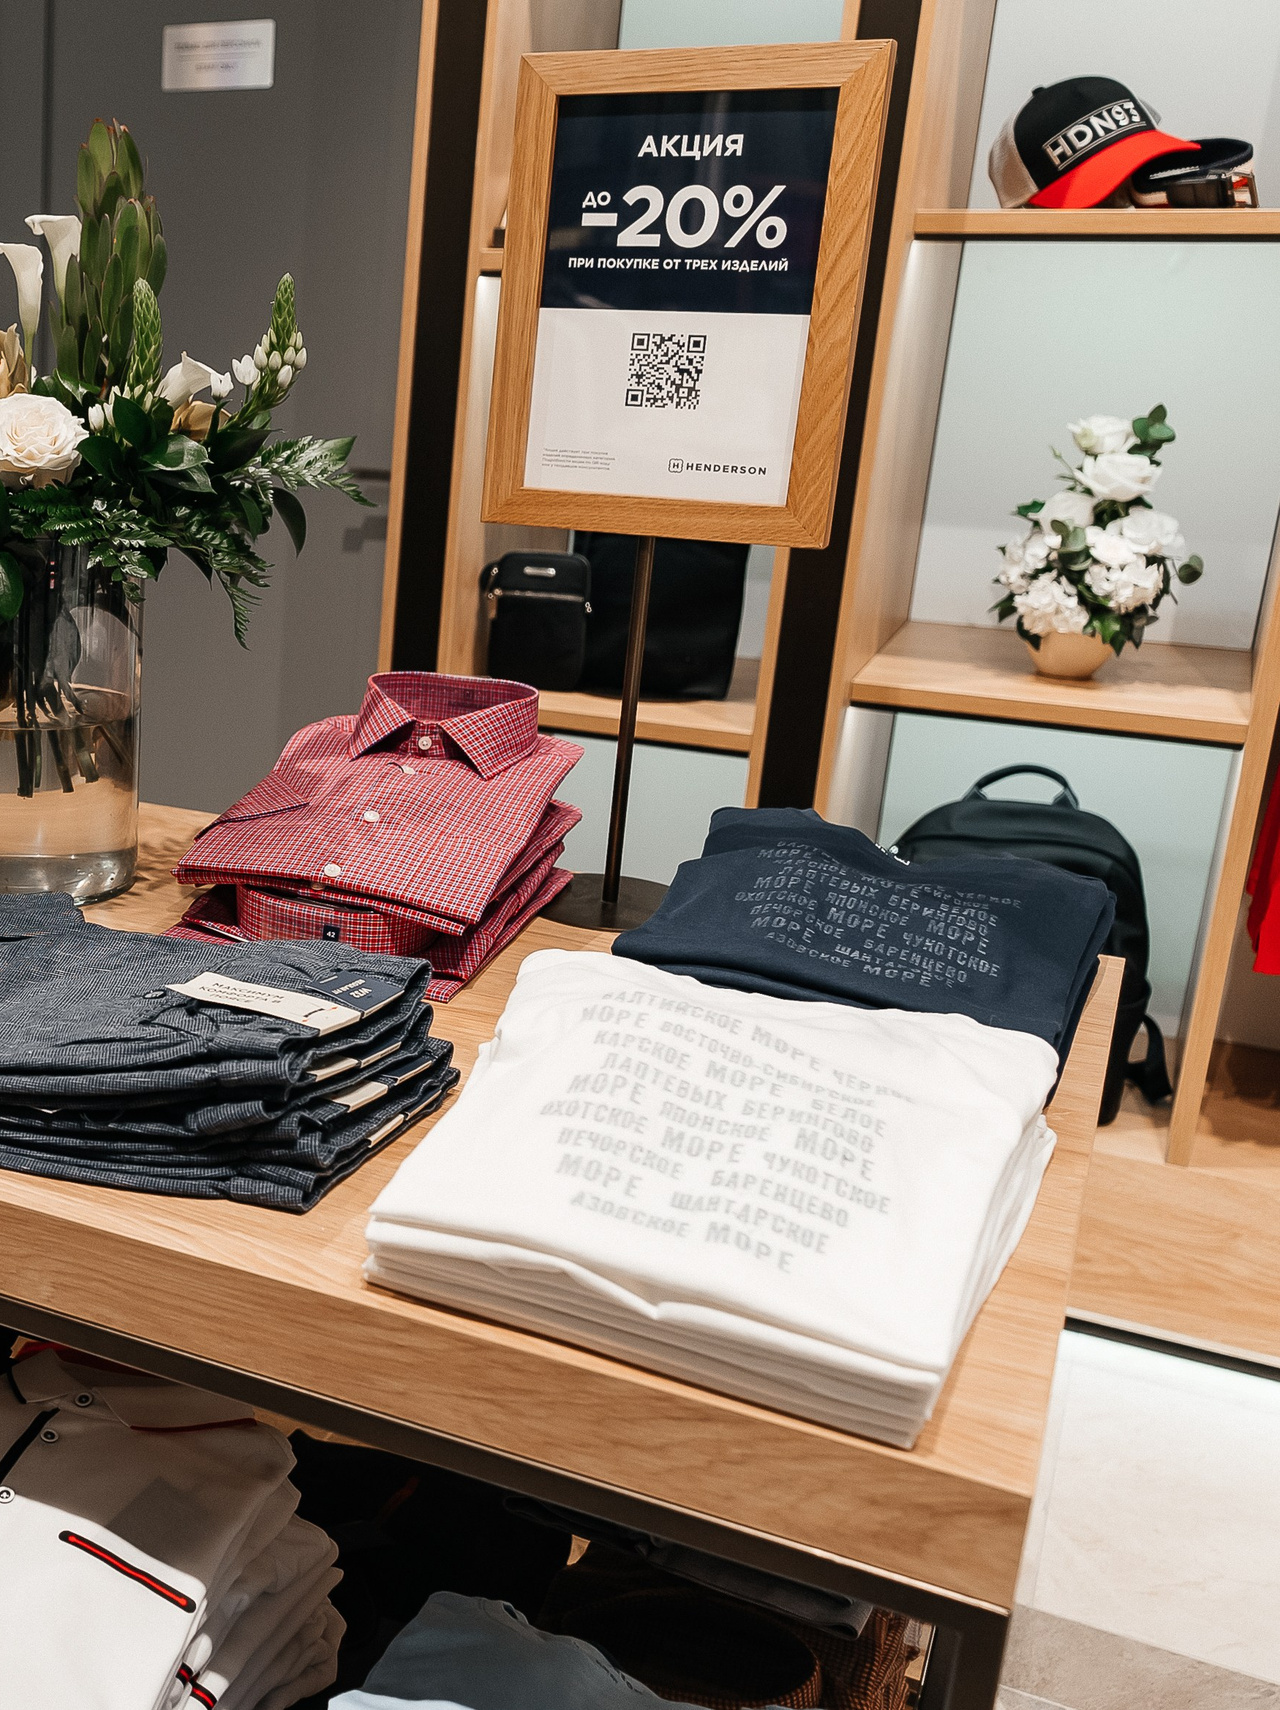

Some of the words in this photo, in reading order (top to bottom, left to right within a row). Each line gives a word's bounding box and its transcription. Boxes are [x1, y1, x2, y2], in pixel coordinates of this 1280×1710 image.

[638, 133, 744, 160] АКЦИЯ
[1045, 101, 1142, 167] HDN93
[582, 191, 611, 209] ДО
[568, 257, 594, 269] ПРИ
[597, 258, 659, 270] ПОКУПКЕ
[663, 259, 682, 270] ОТ
[685, 259, 719, 271] ТРЕХ
[721, 258, 789, 273] ИЗДЕЛИЙ
[686, 462, 767, 475] HENDERSON
[734, 890, 818, 911] ОХОТСКОЕ
[827, 907, 890, 939] МОРЕ
[903, 932, 1000, 977] ЧУКОТСКОЕ
[750, 916, 816, 943] МОРЕ
[753, 876, 816, 894] МОРЕ
[825, 892, 909, 926] ЯПОНСКОЕ
[926, 919, 989, 955] МОРЕ
[863, 939, 968, 983] БАРЕНЦЕВО
[582, 1004, 650, 1029] МОРЕ
[751, 1024, 822, 1072] МОРЕ
[593, 1030, 690, 1071] КАРСКОЕ
[705, 1060, 784, 1098] МОРЕ
[811, 1098, 886, 1138] БЕЛОЕ
[600, 1052, 728, 1111] ЛАПТЕВЫХ
[742, 1099, 874, 1154] БЕРИНГОВО
[540, 1099, 649, 1134] ОХОТСКОЕ
[661, 1126, 744, 1163] МОРЕ
[763, 1151, 891, 1214] ЧУКОТСКОЕ
[567, 1073, 646, 1105] МОРЕ
[659, 1100, 771, 1142] ЯПОНСКОЕ
[794, 1127, 875, 1182] МОРЕ
[556, 1153, 643, 1199] МОРЕ
[670, 1190, 830, 1254] ШАНТАРСКОЕ
[557, 1127, 683, 1180] ПЕЧОРСКОЕ
[710, 1169, 849, 1227] БАРЕНЦЕВО
[569, 1190, 690, 1238] АЗОВСКОЕ
[705, 1221, 794, 1274] МОРЕ
